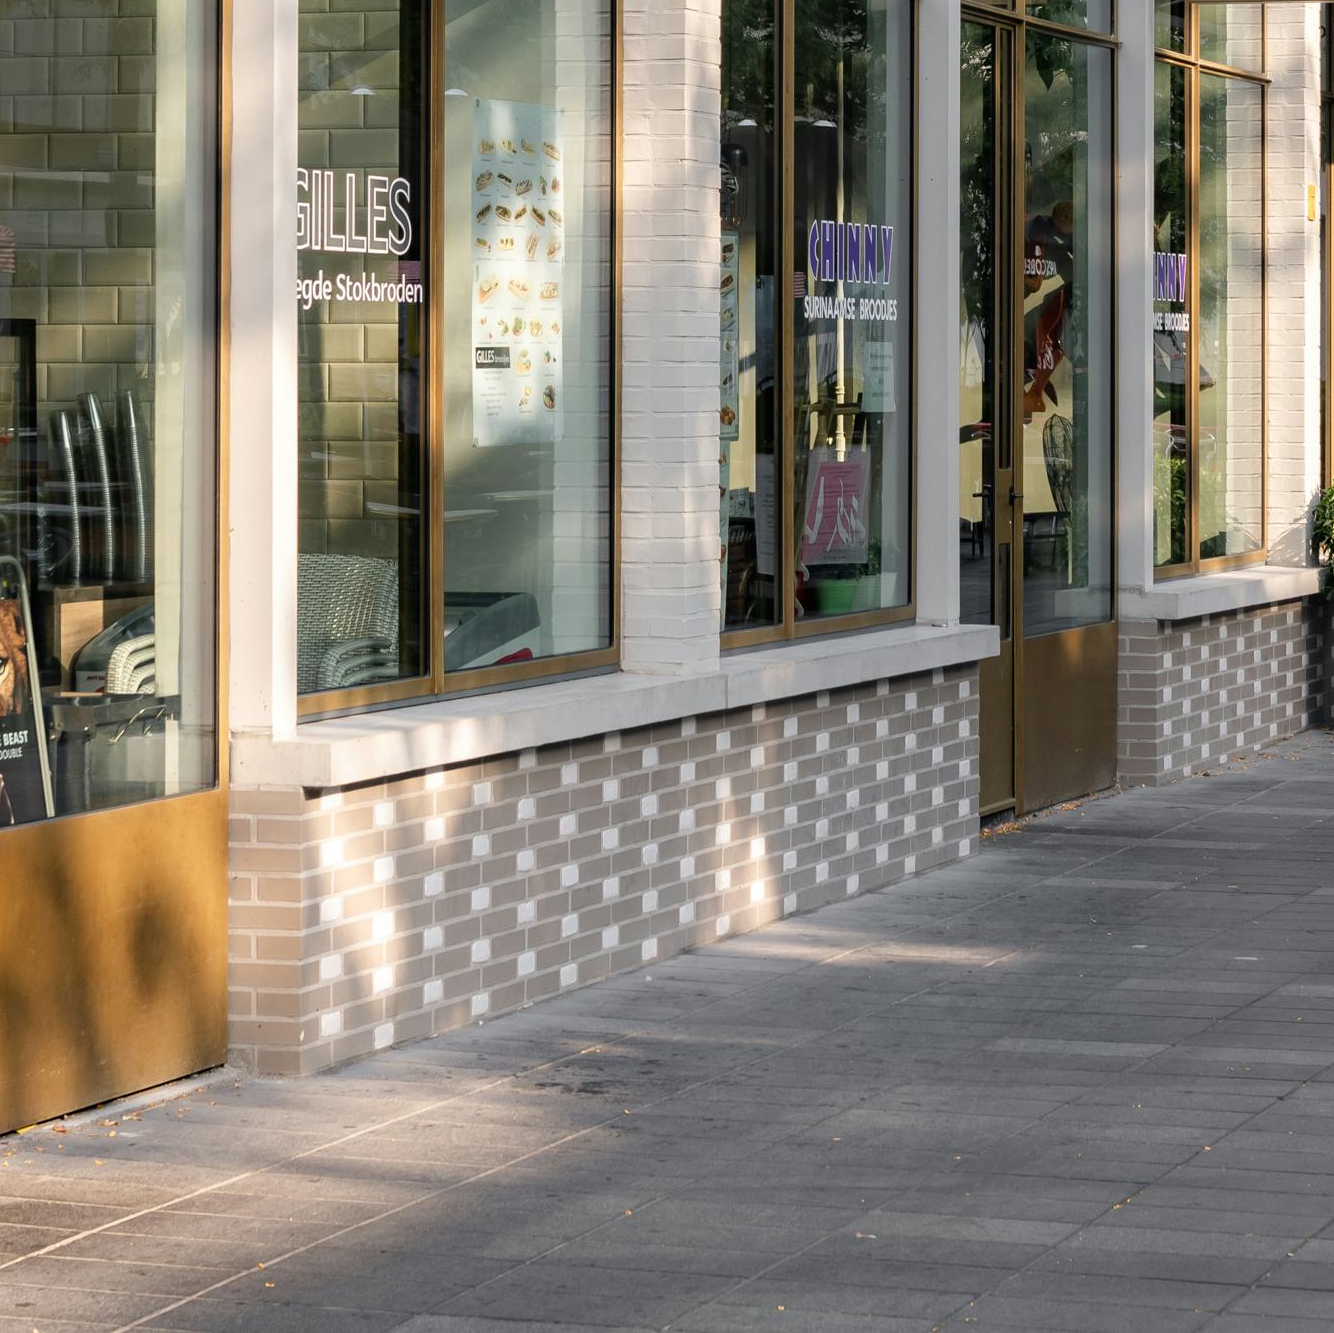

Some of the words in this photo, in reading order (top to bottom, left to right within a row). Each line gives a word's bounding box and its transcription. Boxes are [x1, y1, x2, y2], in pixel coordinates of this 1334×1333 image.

[808, 219, 894, 285] CHINNY
[335, 271, 424, 303] Stokbroden
[804, 295, 856, 320] SURINAAMSE
[859, 298, 898, 321] BROODJES
[476, 349, 495, 364] GILLES
[2, 730, 29, 747] BEAST
